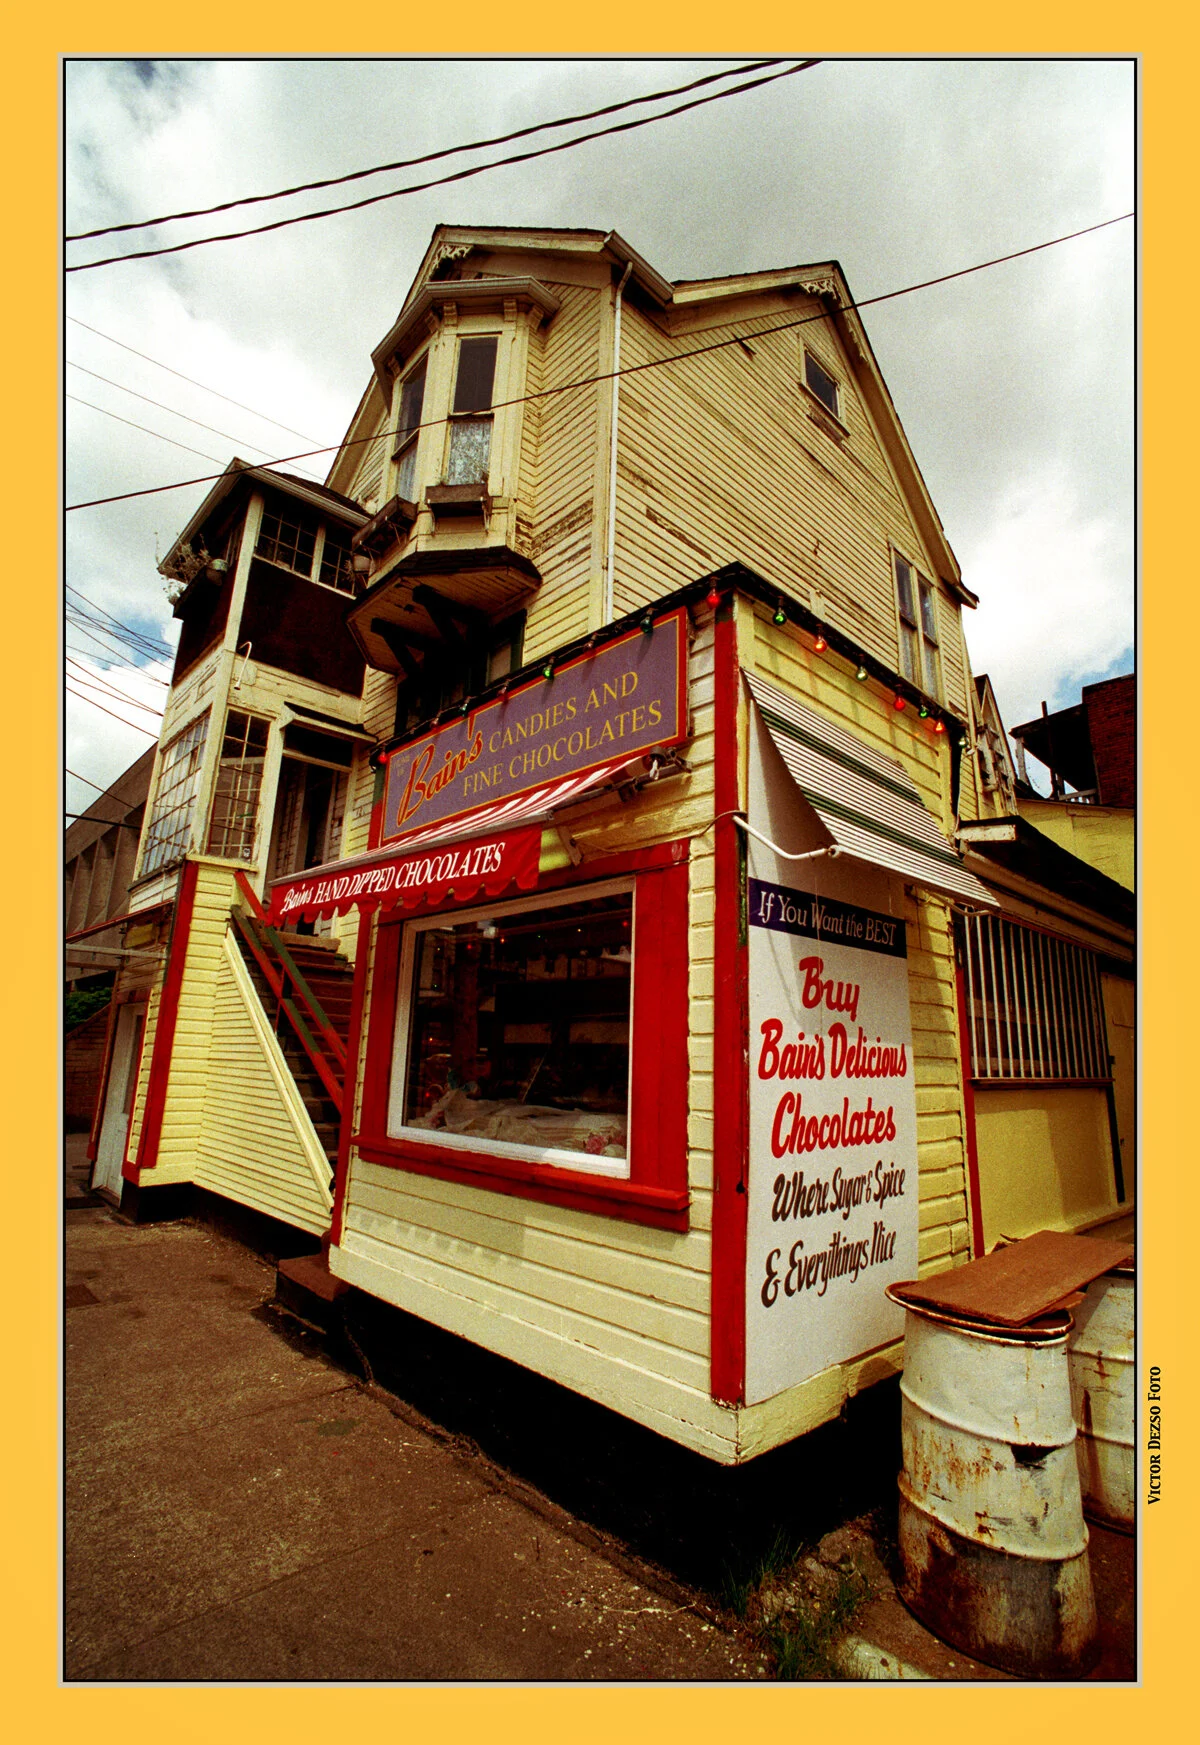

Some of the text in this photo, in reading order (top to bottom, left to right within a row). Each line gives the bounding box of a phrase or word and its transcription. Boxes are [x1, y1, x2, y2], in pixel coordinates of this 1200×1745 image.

[397, 670, 639, 827] Bain's CANDIES AND
[463, 700, 662, 797] FINE CHOCOLATES
[280, 842, 506, 915] Bains HAND DIPPED CHOCOLATES
[758, 890, 897, 946] If You Want the BEST
[799, 956, 860, 1022] Buy
[757, 1018, 907, 1080] Bain's Delicious
[771, 1091, 897, 1158] Chocolates
[771, 1159, 906, 1222] Where Sugar & Spice
[761, 1248, 781, 1308] &
[870, 1220, 897, 1266] Nice
